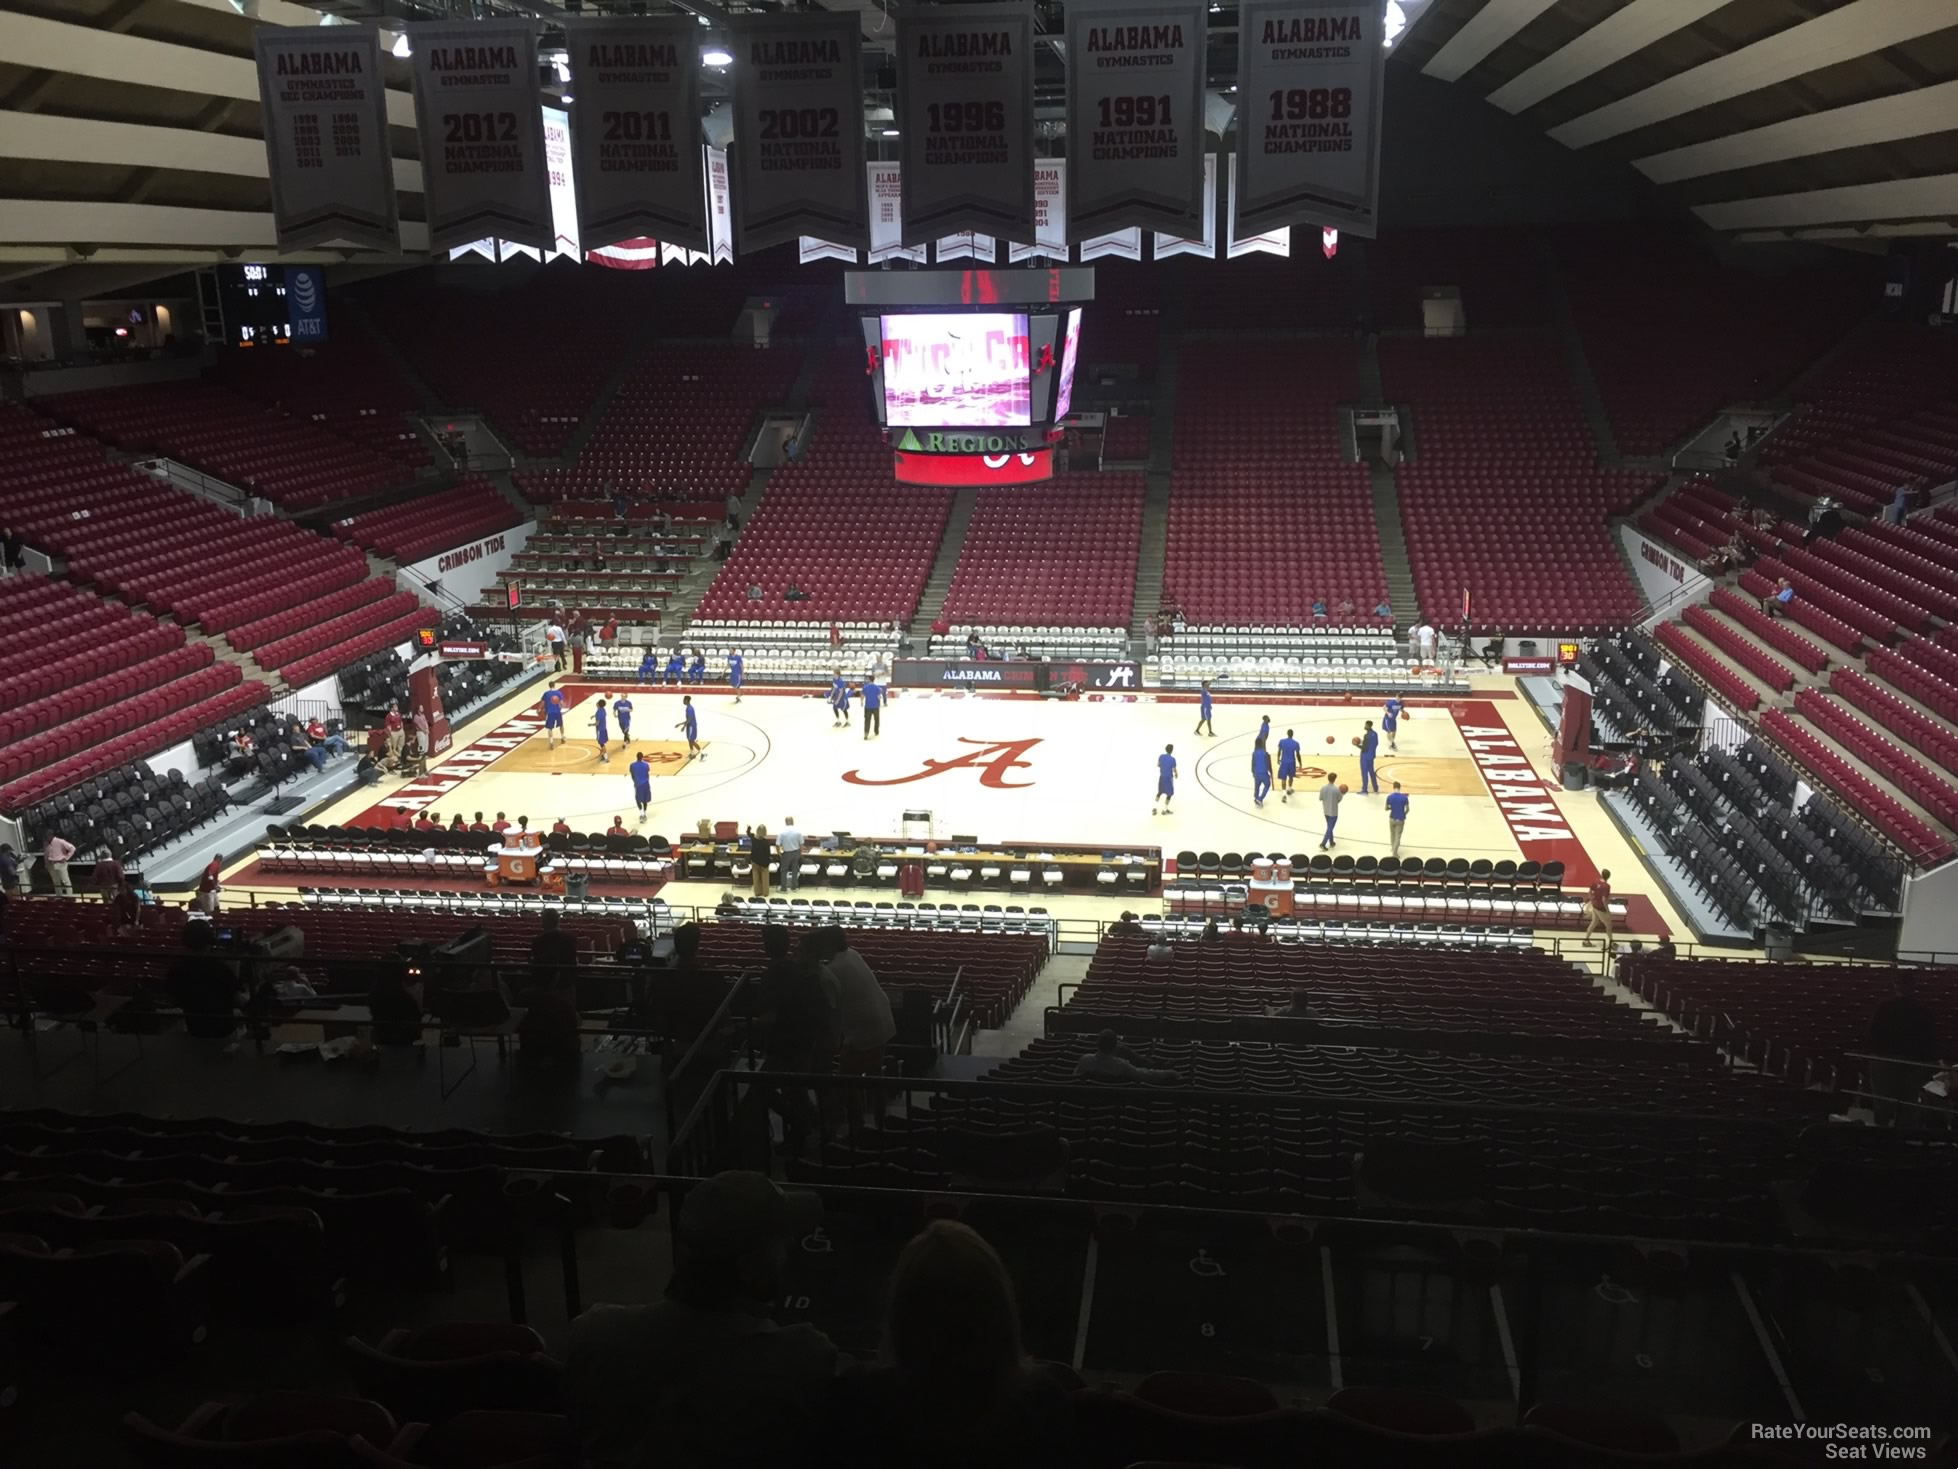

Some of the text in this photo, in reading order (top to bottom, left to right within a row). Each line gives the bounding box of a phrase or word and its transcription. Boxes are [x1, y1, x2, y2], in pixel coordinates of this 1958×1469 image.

[1262, 16, 1361, 44] ALABAMA
[918, 32, 1012, 58] ALABAMA
[1087, 25, 1183, 52] ALABAMA
[430, 46, 518, 71] ALABAMA
[589, 45, 678, 68] ALABAMA
[751, 40, 841, 65] ALABAMA
[1271, 47, 1351, 60] GYMNASTICS
[277, 51, 363, 75] ALABAMA
[928, 61, 1002, 74] GYMNASTICS
[1097, 54, 1174, 68] GYMNASTICS
[440, 74, 510, 86] GYMNASTICS
[598, 72, 670, 83] GYMNASTICS
[760, 69, 832, 81] GYMNASTICS
[287, 79, 355, 90] GYMNASTICS
[302, 89, 365, 101] CHAMPIONS
[1098, 95, 1172, 127] 1991
[1270, 88, 1352, 120] 1988
[759, 108, 839, 139] 2002
[927, 101, 1005, 132] 1996
[443, 112, 518, 142] 2012
[603, 111, 671, 141] 2011
[1265, 122, 1352, 139] NATIONAL
[925, 136, 1008, 151] NATIONAL
[1093, 129, 1178, 146] NATIONAL
[444, 144, 522, 160] NATIONAL
[600, 144, 678, 158] NATIONAL
[760, 142, 841, 157] NATIONAL
[1093, 145, 1178, 160] CHAMPIONS
[1264, 139, 1352, 154] CHAMPIONS
[600, 159, 679, 172] CHAMPIONS
[761, 157, 841, 171] CHAMPIONS
[926, 151, 1008, 165] CHAMPIONS
[446, 160, 524, 174] CHAMPIONS
[298, 319, 321, 336] AT&T
[928, 432, 1028, 453] REGIONS
[439, 535, 505, 573] CRIMSON TIDE
[943, 670, 1002, 680] ALABAMA
[1460, 725, 1574, 841] ALABAMA
[510, 860, 523, 874] G
[1264, 894, 1279, 909] G
[783, 1295, 811, 1309] 10
